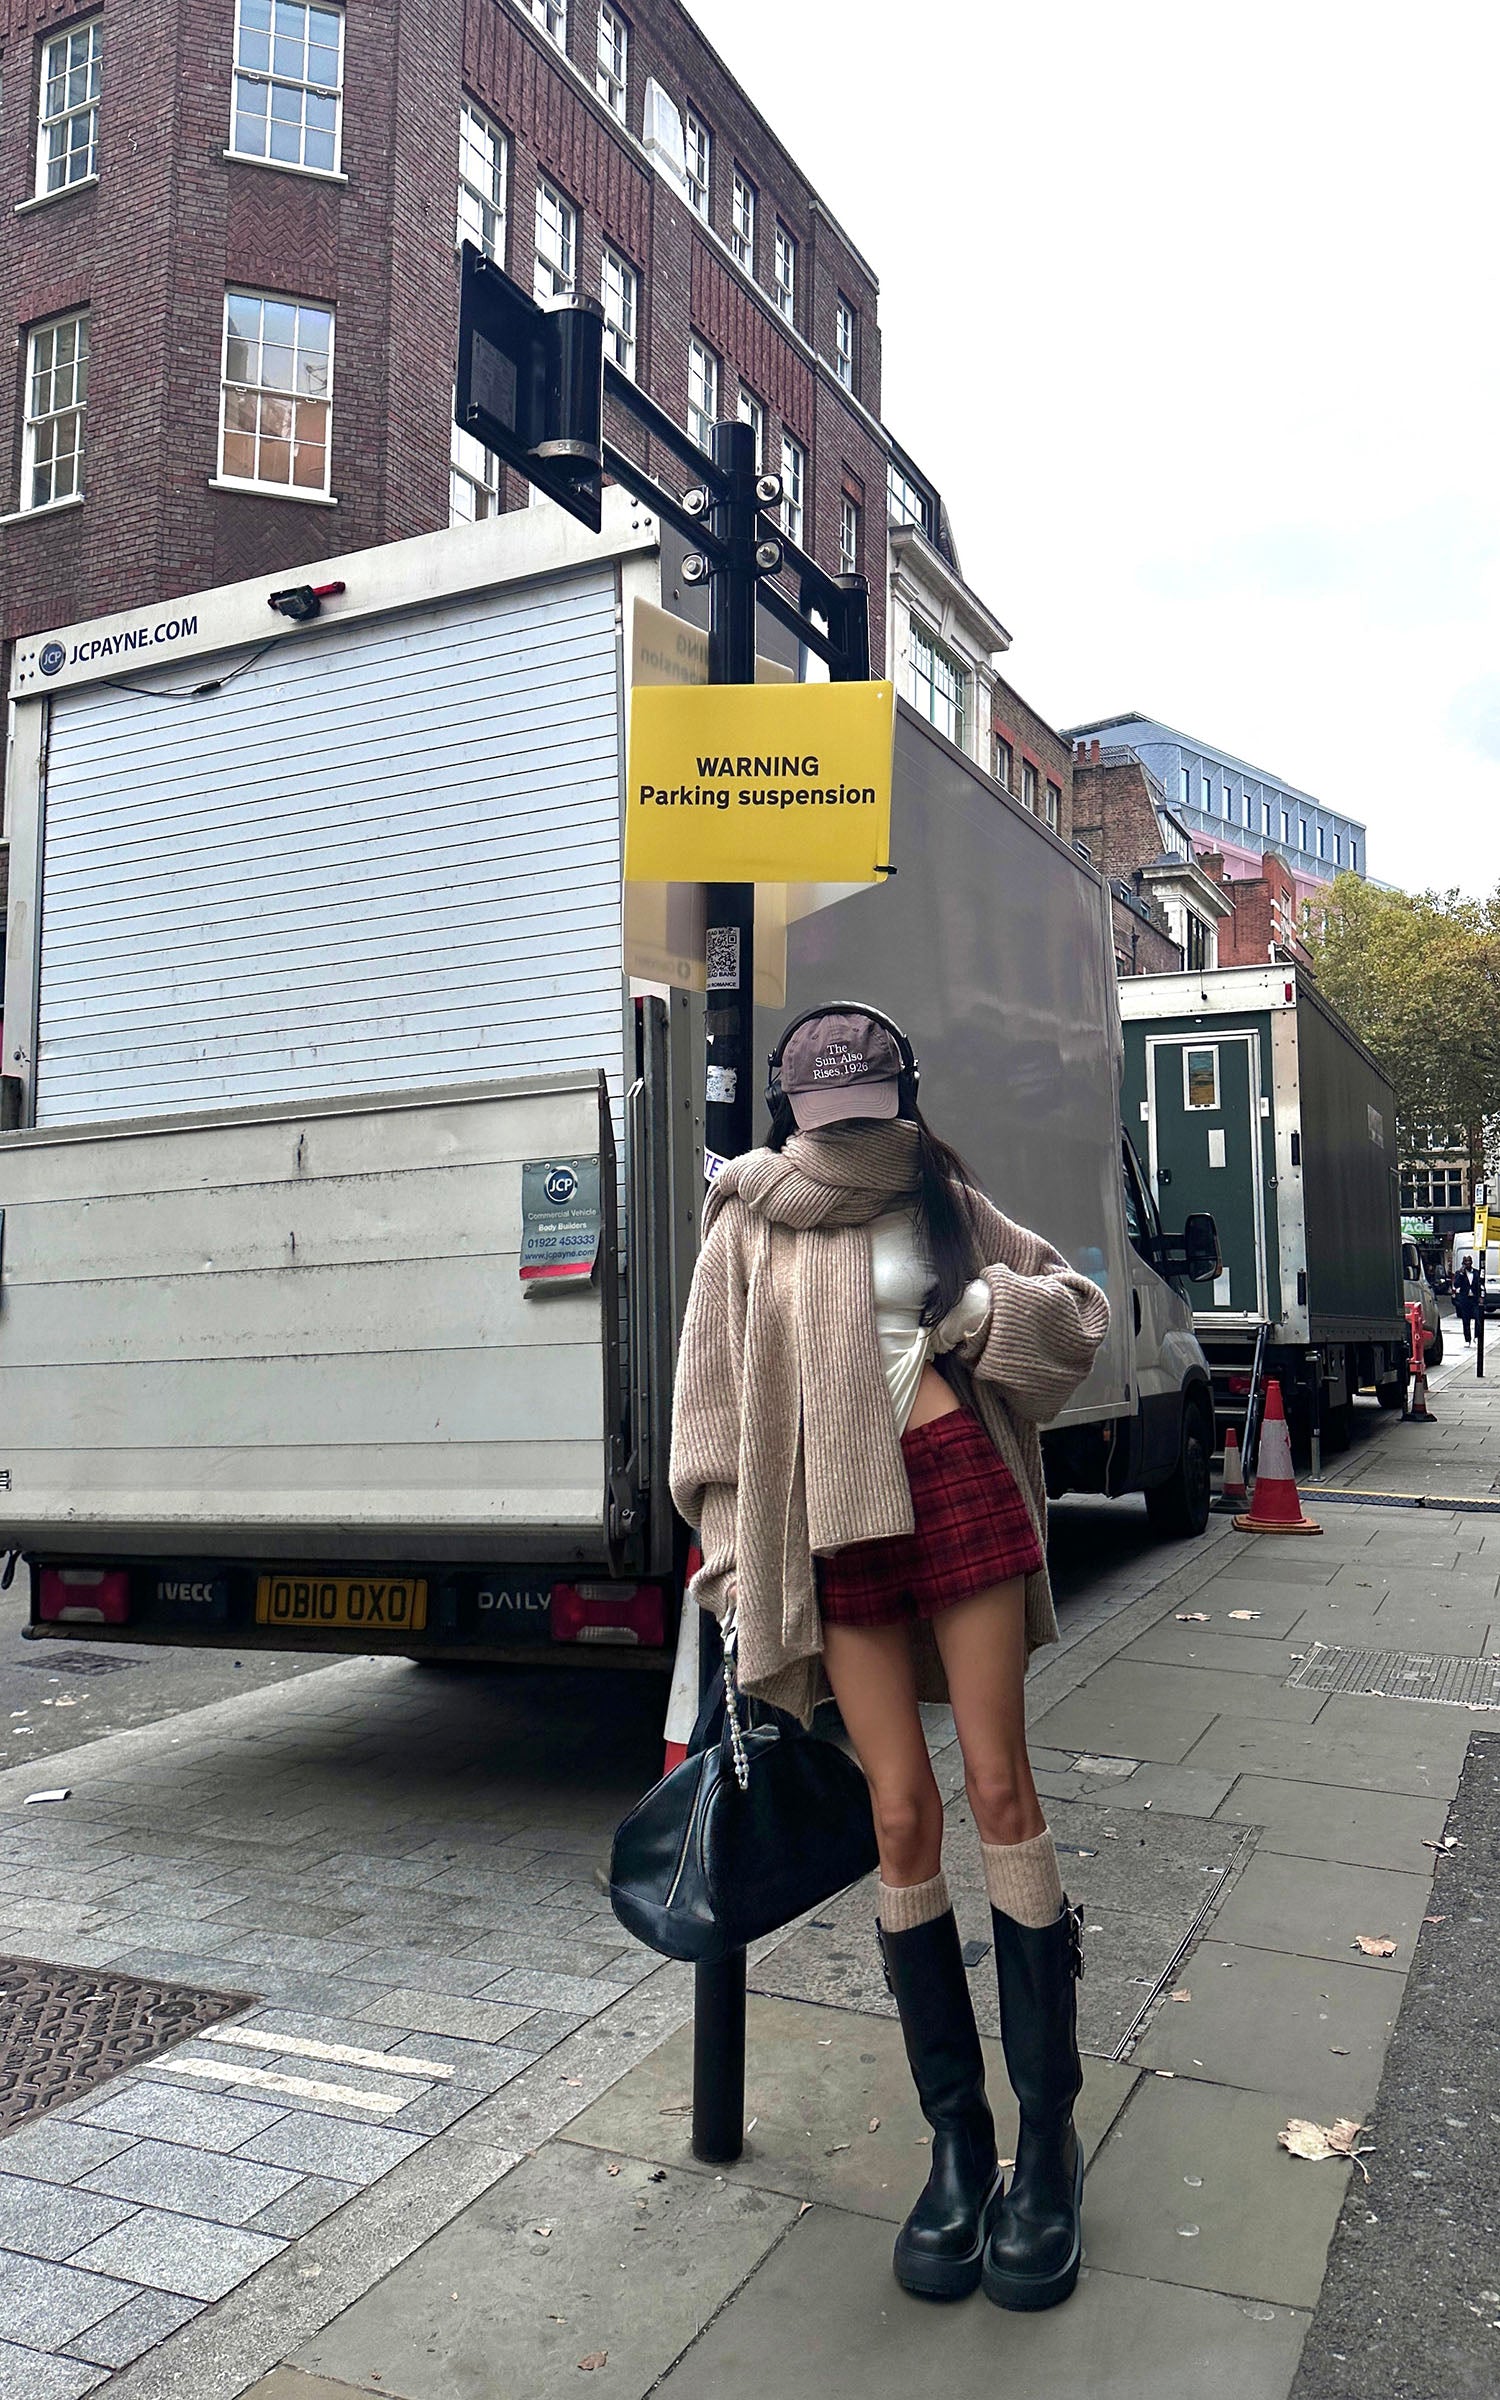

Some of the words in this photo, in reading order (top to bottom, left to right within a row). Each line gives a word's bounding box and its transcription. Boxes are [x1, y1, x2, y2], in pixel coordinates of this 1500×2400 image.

[70, 616, 198, 665] JCPAYNE.COM
[43, 652, 62, 666] JCP
[696, 756, 819, 777] WARNING
[640, 785, 730, 809] Parking
[738, 784, 876, 809] suspension
[827, 1044, 848, 1055] The
[815, 1057, 837, 1067] Sun
[840, 1052, 863, 1063] Also
[549, 1178, 573, 1192] JCP
[527, 1209, 570, 1220] Commercial
[572, 1208, 597, 1217] Vehicle
[538, 1223, 557, 1232] Body
[558, 1221, 587, 1231] Builders
[527, 1237, 557, 1248] 01922
[559, 1235, 595, 1245] 453333
[525, 1249, 595, 1260] www.jcpayne.com
[478, 1591, 552, 1610] DAILY
